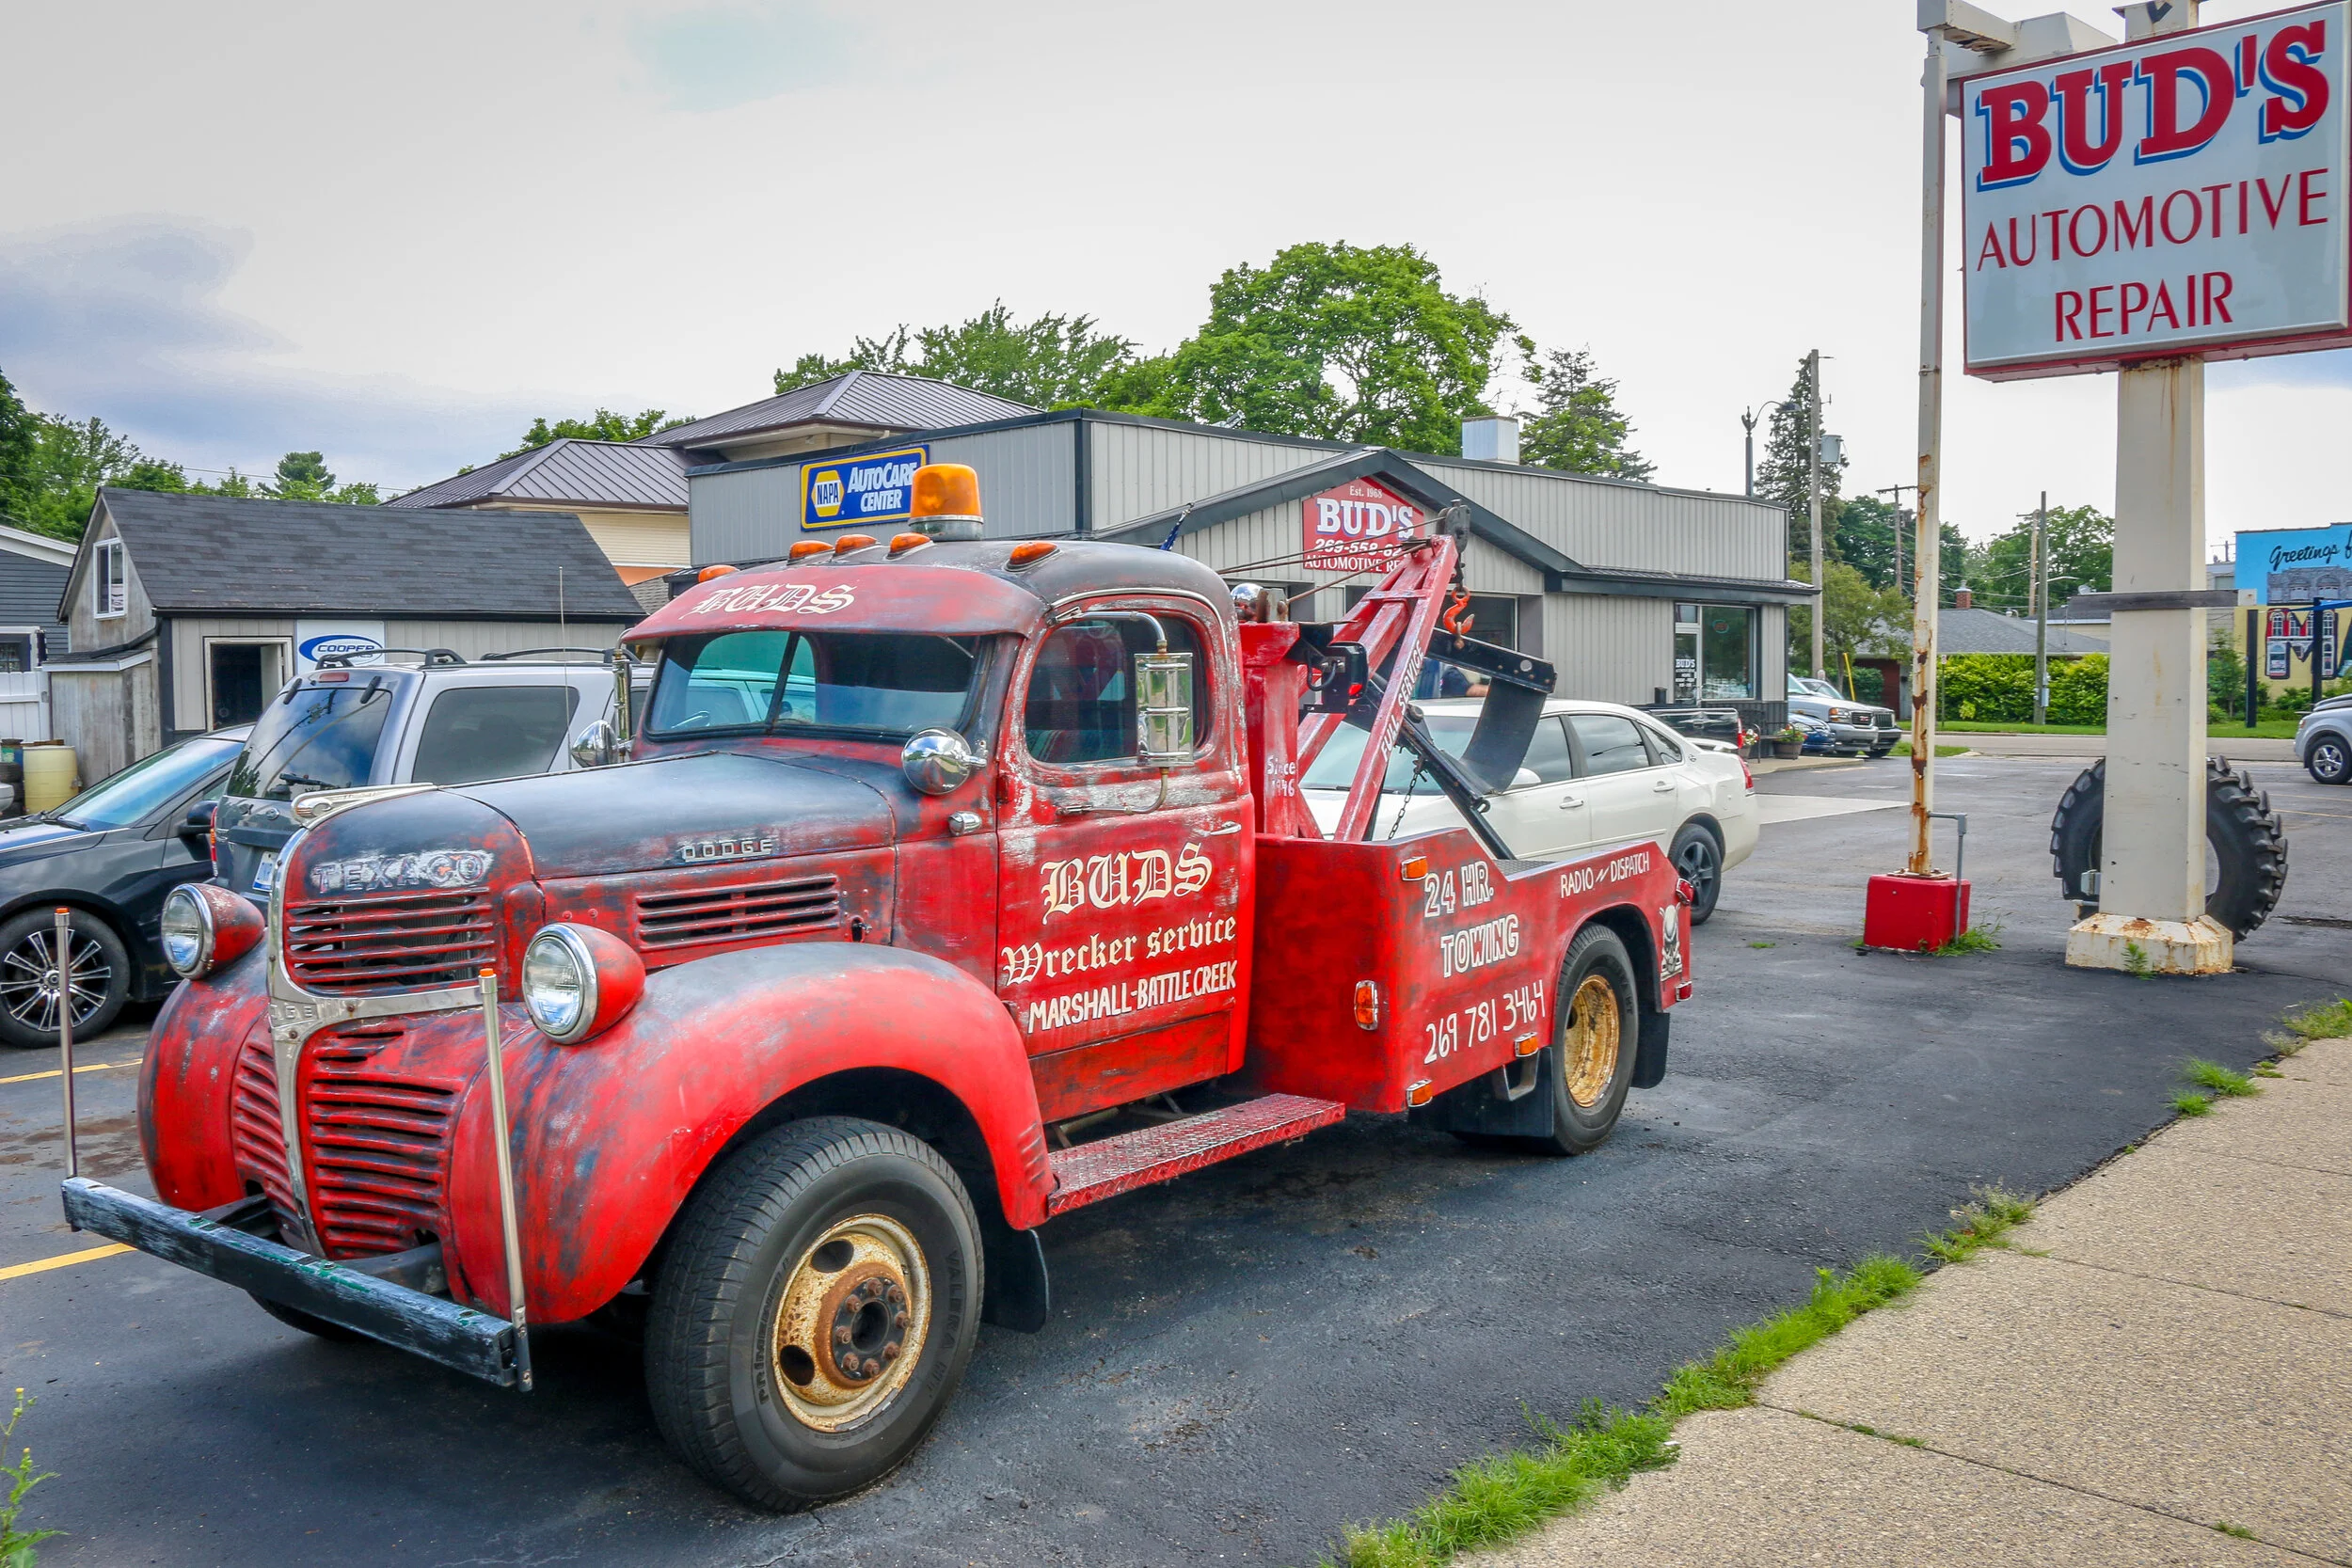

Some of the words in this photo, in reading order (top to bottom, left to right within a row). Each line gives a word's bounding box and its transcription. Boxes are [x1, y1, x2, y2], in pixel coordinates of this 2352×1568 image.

[1976, 19, 2329, 192] BUD'S
[1977, 167, 2328, 271] AUTOMOTIVE
[2055, 271, 2233, 342] REPAIR
[817, 482, 839, 505] NAPA
[860, 489, 902, 513] CENTER
[1349, 485, 1364, 497] Est.
[1366, 487, 1383, 499] 1968
[1316, 498, 1414, 540] BUD'S
[1304, 553, 1383, 572] AUTOMOTIVE
[2269, 545, 2340, 571] Greetings
[678, 583, 857, 620] BUDS
[1381, 714, 1400, 763] FULL
[1398, 641, 1424, 716] SERVICE
[1267, 754, 1295, 775] Since
[681, 838, 773, 863] DODGE
[314, 852, 485, 894] TEXACO
[1040, 842, 1213, 925] BUDS
[1423, 870, 1455, 917] 24
[1461, 861, 1494, 907] HR.
[1560, 867, 1594, 898] RADIO
[1610, 851, 1650, 882] DISPATCH
[1001, 933, 1137, 987] Wrecker
[1145, 911, 1237, 958] service
[1440, 913, 1519, 977] TOWING
[1193, 960, 1238, 996] CREEK
[1423, 1013, 1458, 1064] 269
[1465, 999, 1497, 1048] 781
[1502, 979, 1547, 1031] 3464
